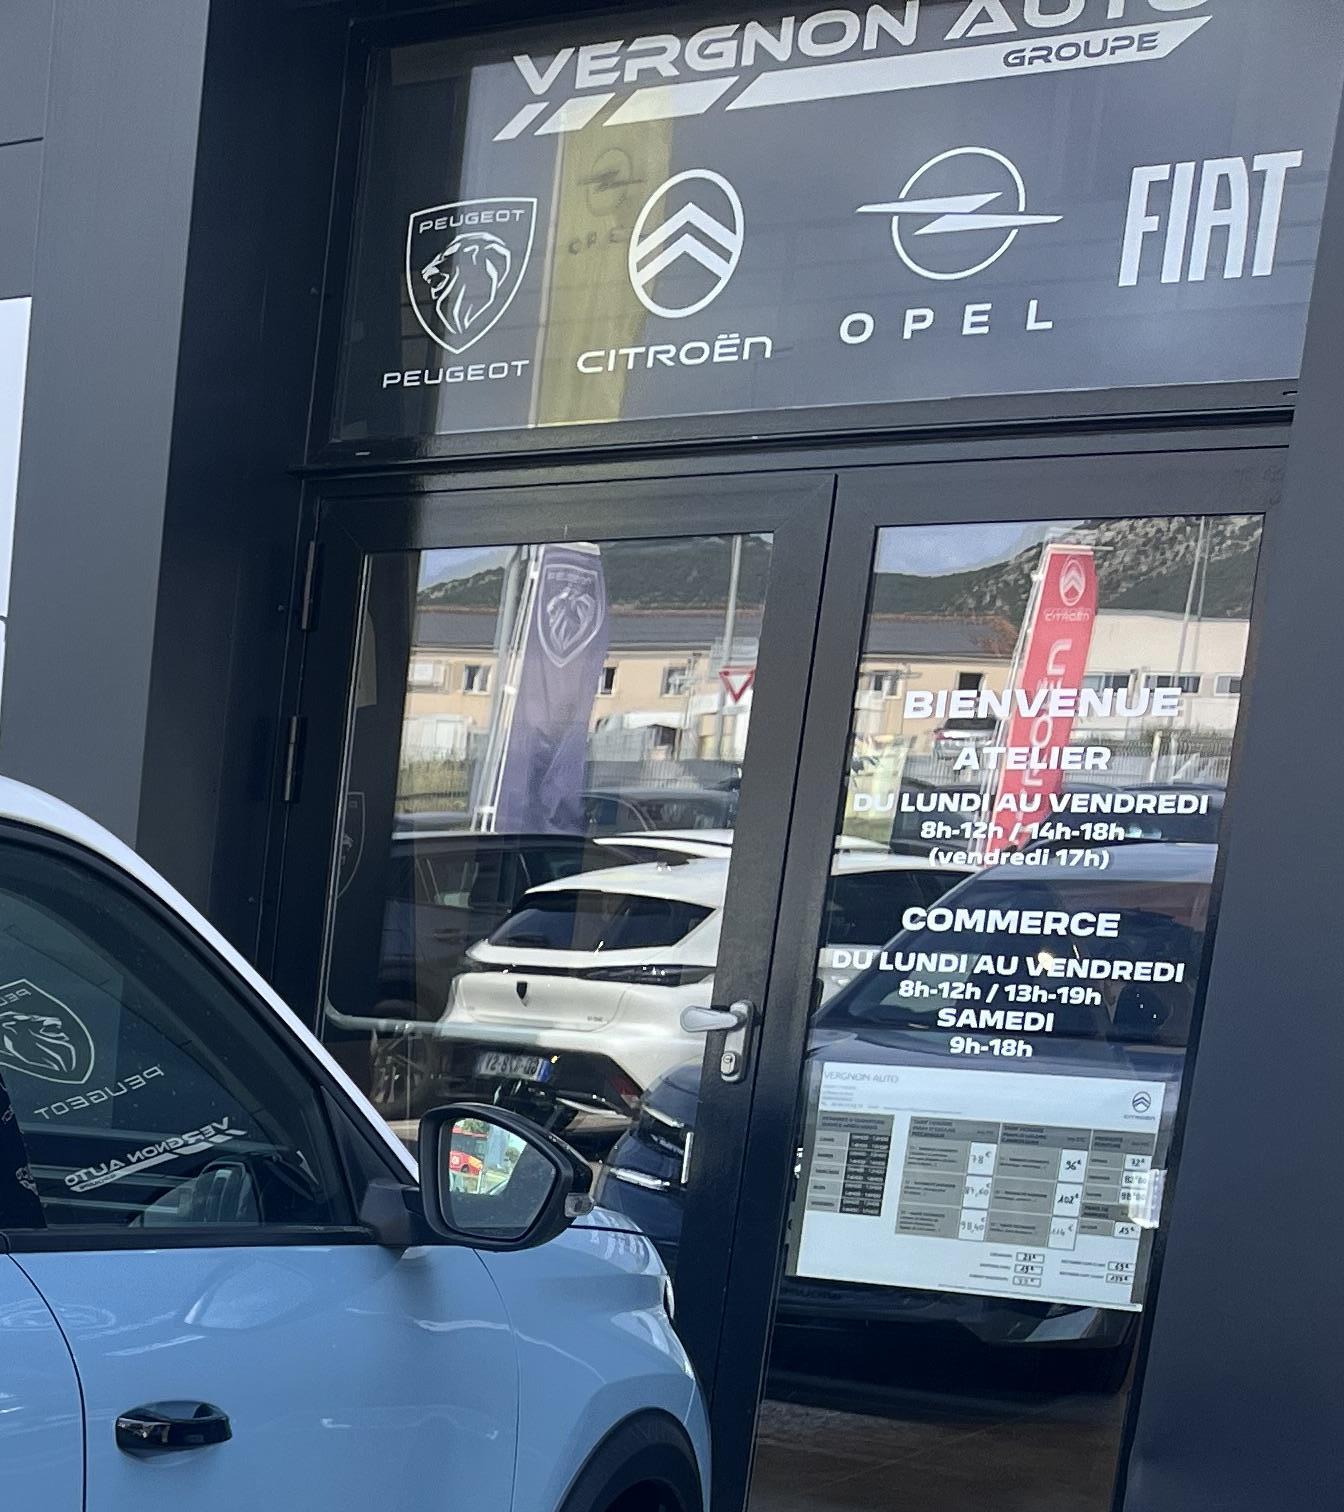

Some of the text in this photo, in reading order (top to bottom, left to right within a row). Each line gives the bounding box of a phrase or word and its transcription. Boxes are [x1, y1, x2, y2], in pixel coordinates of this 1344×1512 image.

[512, 0, 1212, 97] VERGNON AU
[1002, 31, 1161, 67] GROUPE
[419, 208, 525, 234] PEUGEOT
[1118, 150, 1303, 287] FIAT
[839, 299, 1054, 345] OPEL
[382, 359, 530, 389] PEUGEOT
[902, 687, 1183, 720] BIENVENUE
[952, 745, 1112, 771] ATELIER
[852, 793, 1209, 815] DU LUNDI AU VENDREDI
[919, 819, 1003, 841] 8h-12h
[1028, 821, 1126, 842] 14h-18h
[928, 848, 1110, 870] (vendredi 17h)
[901, 906, 1122, 938] COMMERCE
[831, 949, 1185, 984] DU LUNDI AU VENDREDI
[898, 981, 982, 1002] 8h-12h
[1004, 984, 1102, 1007] 13h-19h
[937, 1007, 1054, 1032] SAMEDI
[949, 1035, 1033, 1058] 9h-18h
